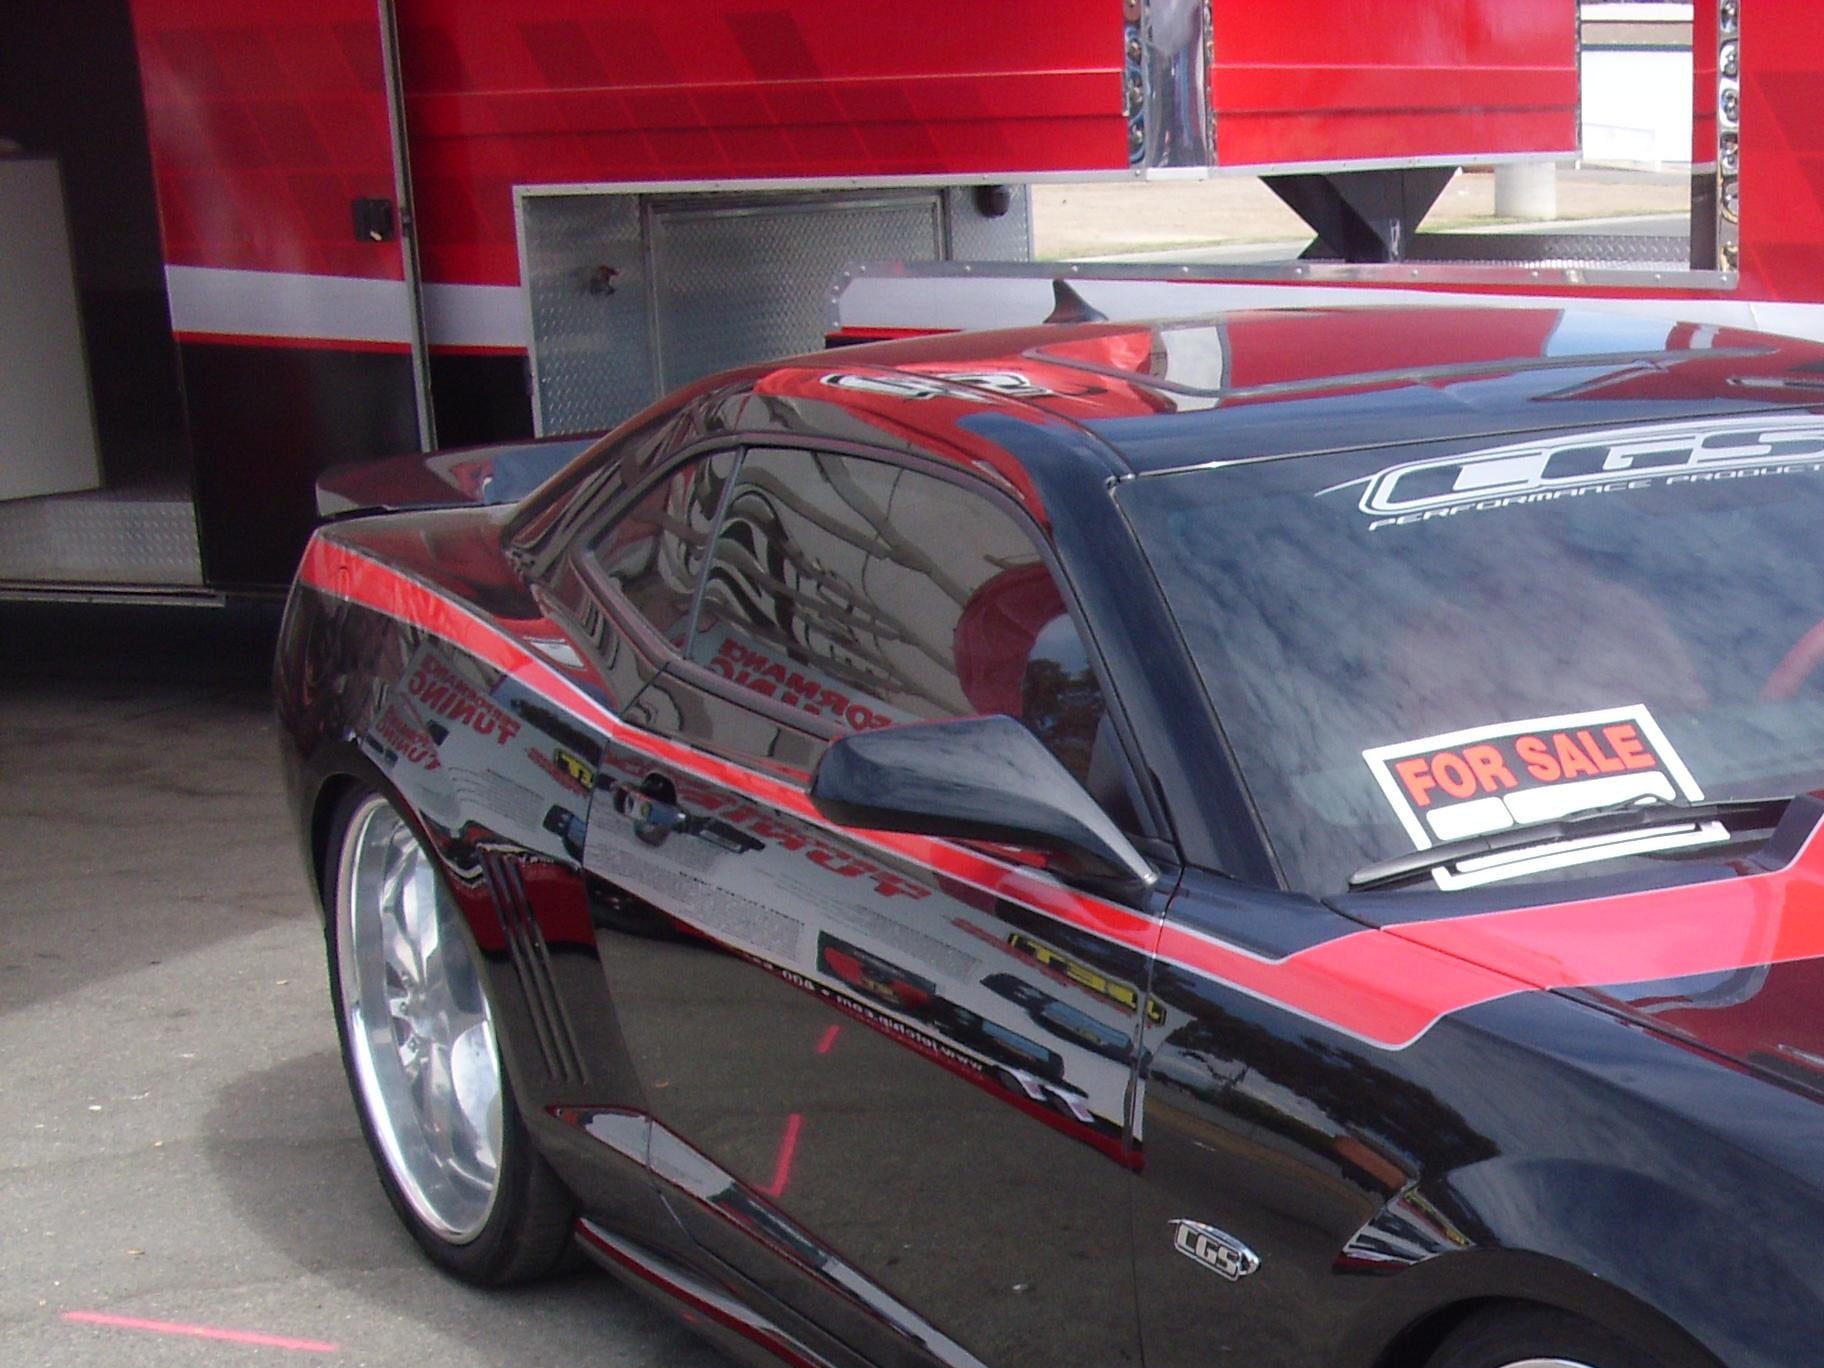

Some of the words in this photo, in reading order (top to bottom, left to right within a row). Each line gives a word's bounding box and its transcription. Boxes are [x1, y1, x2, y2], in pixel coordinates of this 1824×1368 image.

[1368, 479, 1652, 531] PERFORMANCE
[1395, 744, 1519, 808] FOR
[1514, 722, 1657, 783] SALE
